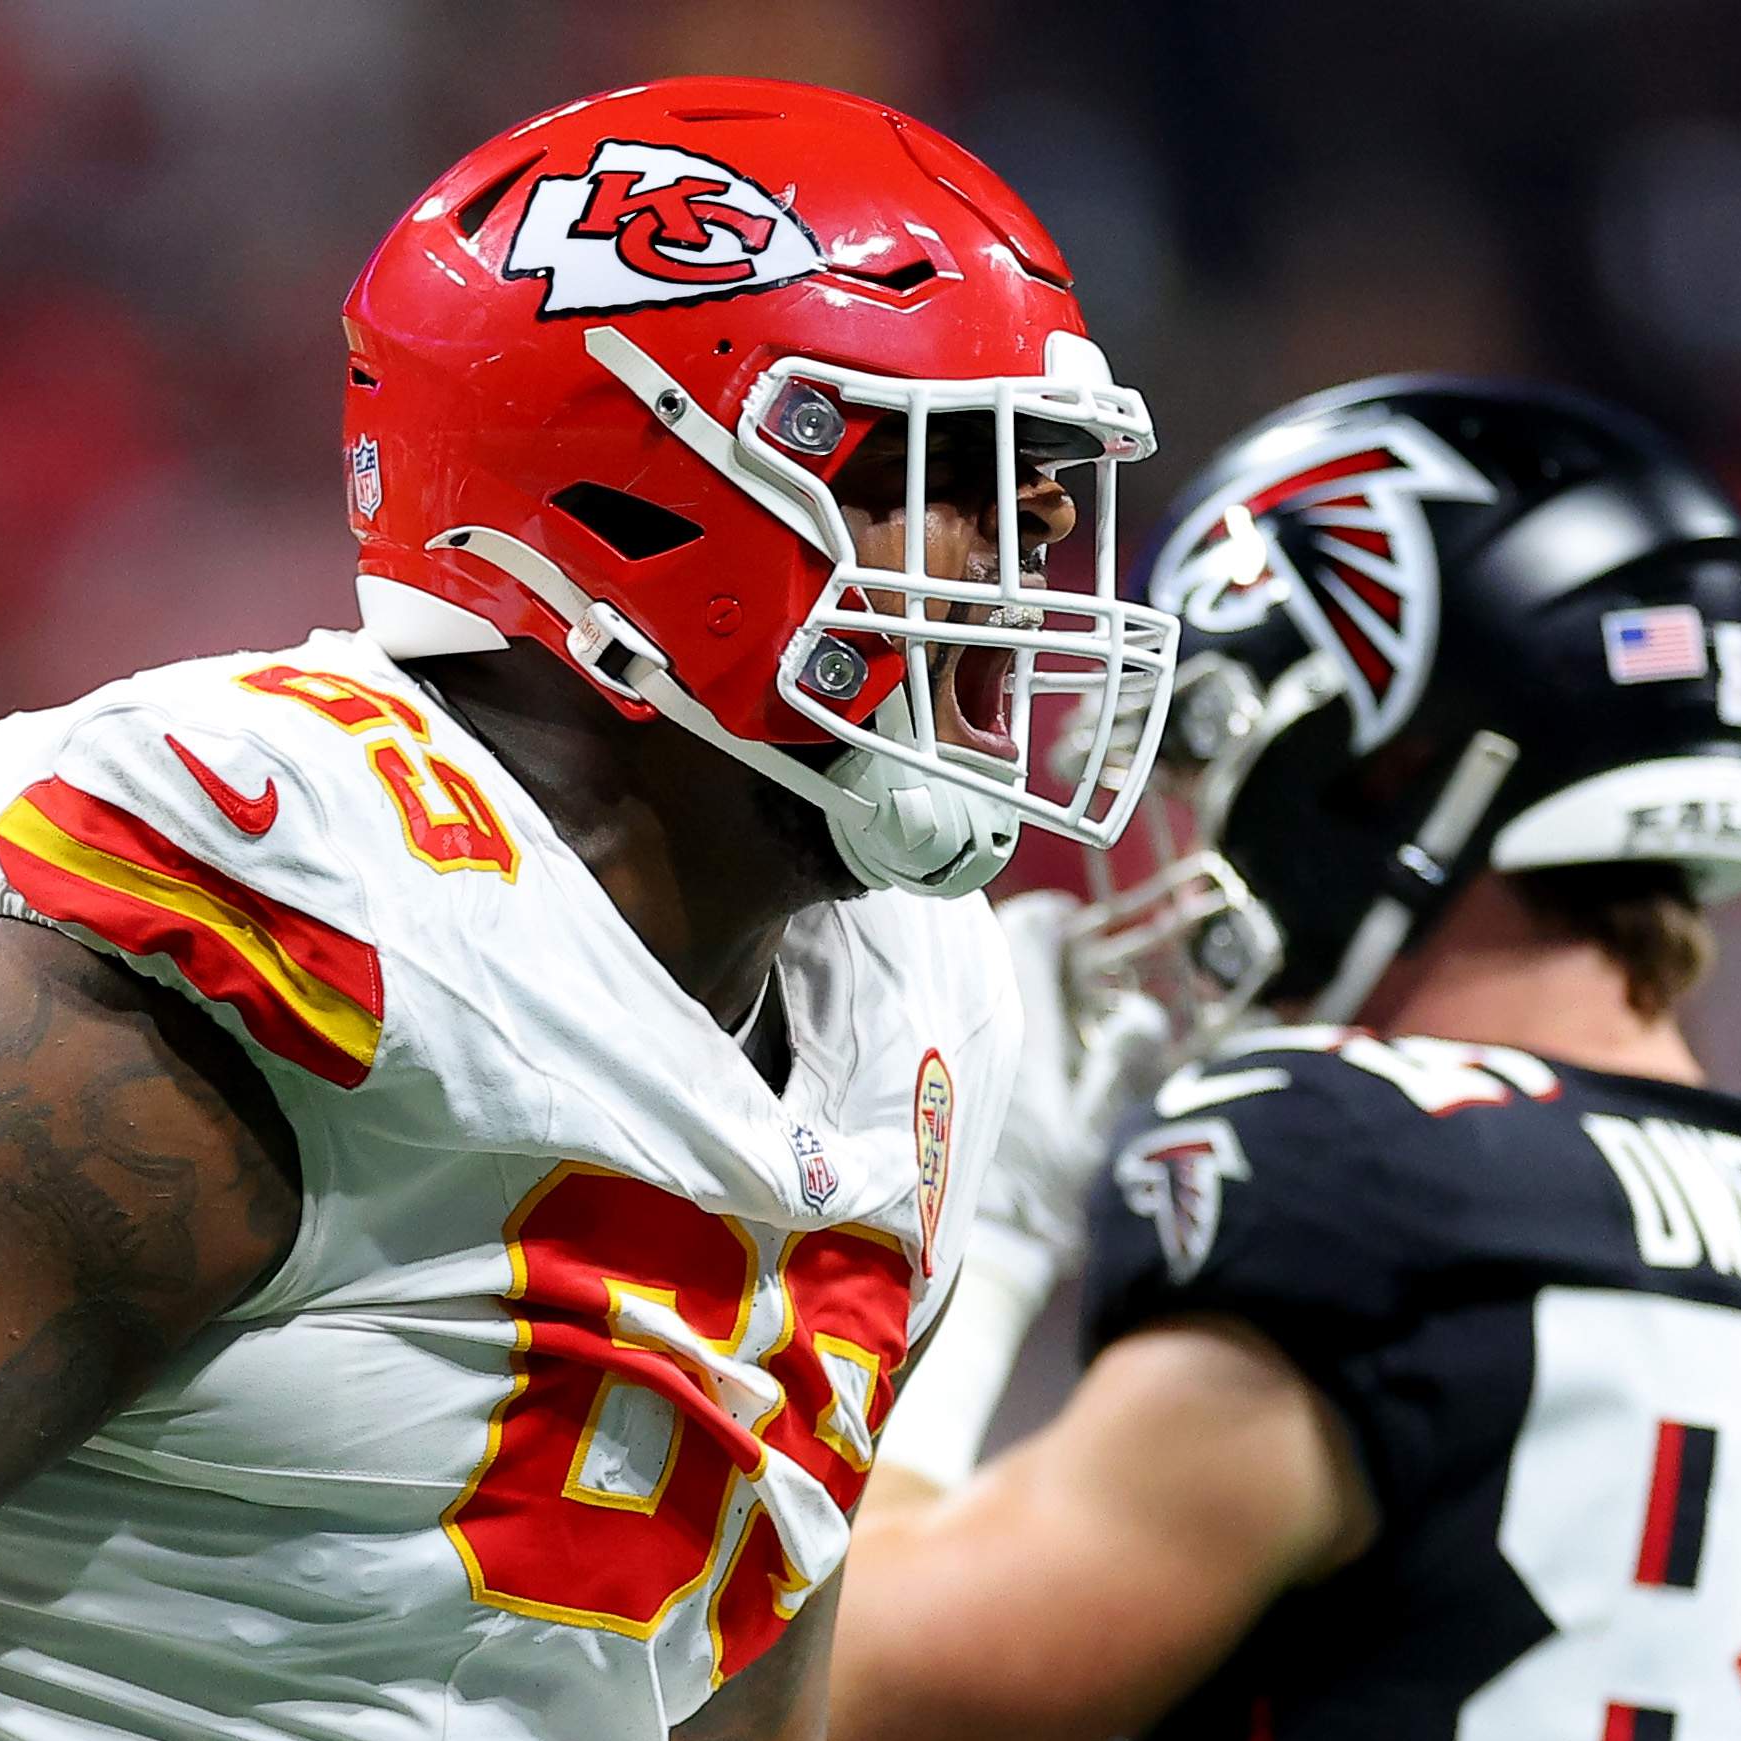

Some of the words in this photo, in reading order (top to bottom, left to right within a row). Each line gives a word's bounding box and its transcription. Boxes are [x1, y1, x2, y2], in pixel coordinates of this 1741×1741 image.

[567, 171, 777, 285] KC
[231, 664, 521, 885] 69
[804, 1156, 835, 1195] NFL
[440, 1160, 911, 1691] 69
